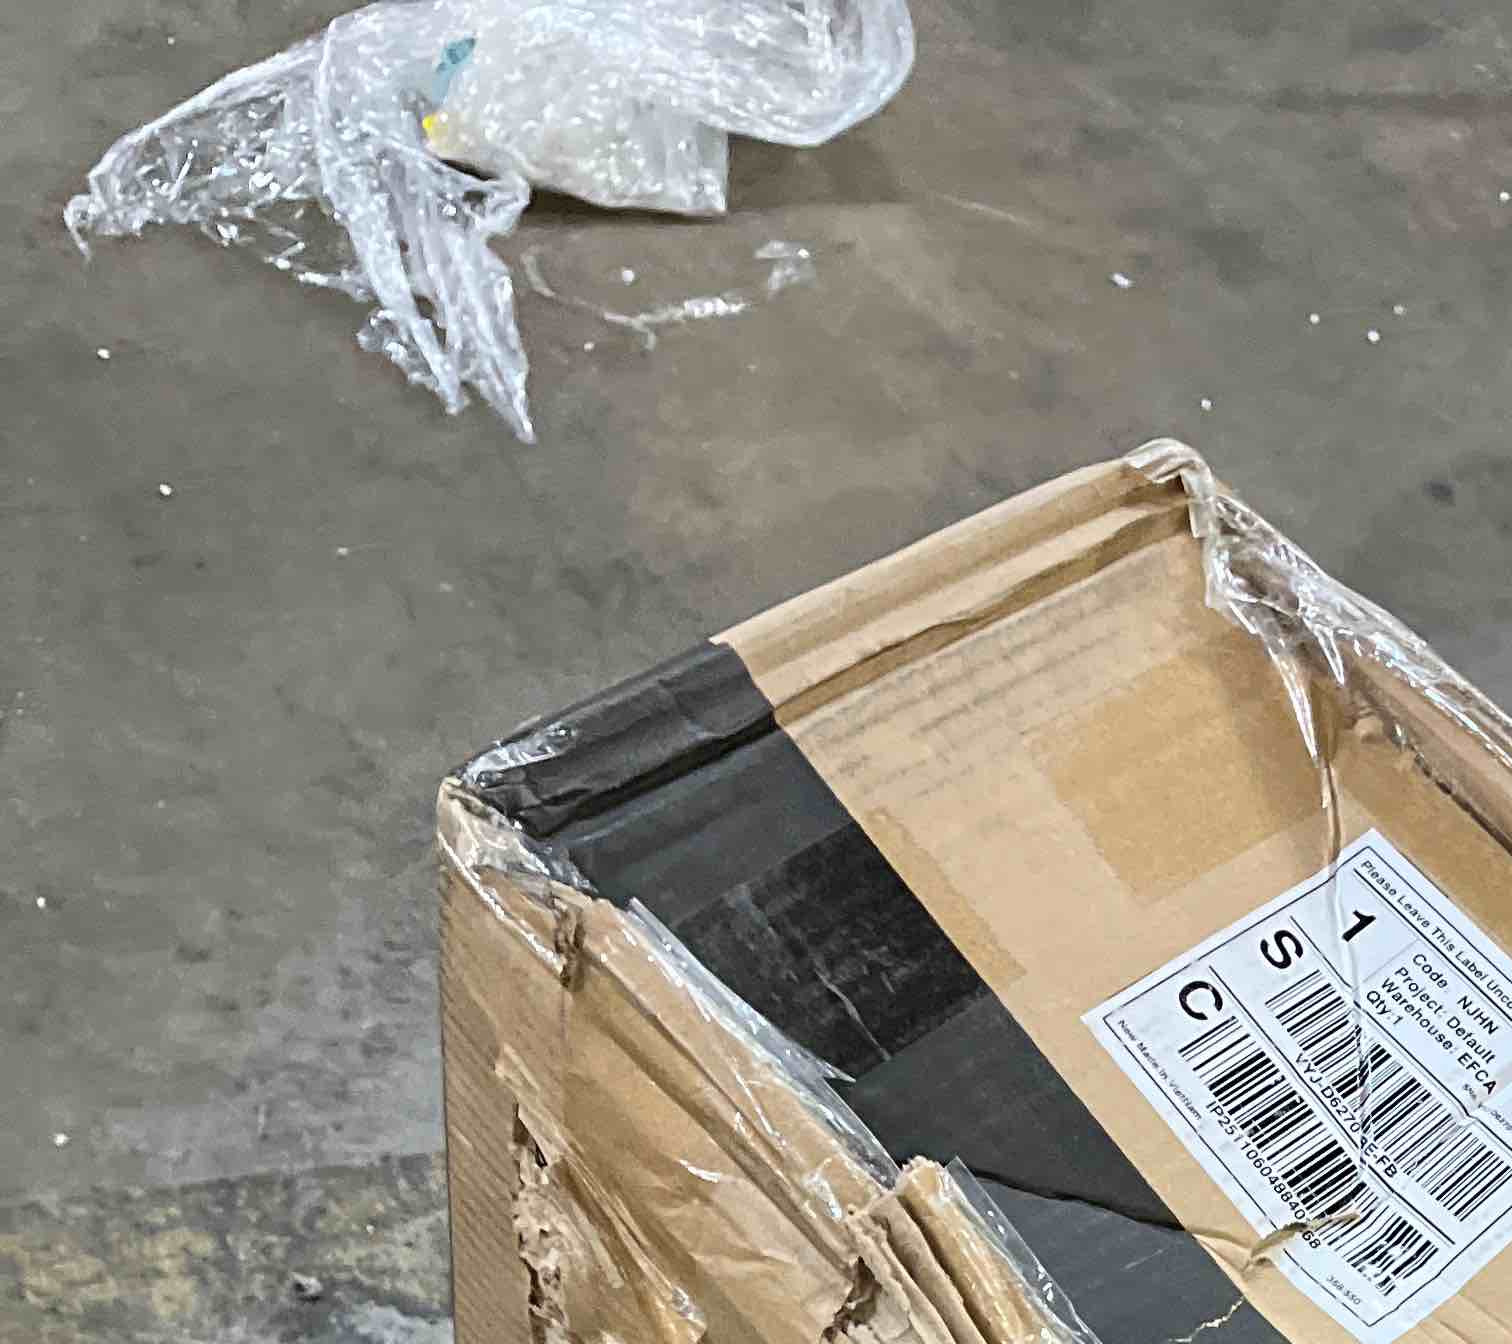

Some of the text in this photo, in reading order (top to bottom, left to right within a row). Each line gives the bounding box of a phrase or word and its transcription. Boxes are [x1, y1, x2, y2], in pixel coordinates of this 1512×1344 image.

[1342, 910, 1376, 942] 1
[1361, 861, 1396, 895] Please
[1398, 896, 1430, 927] Leave
[1432, 927, 1454, 951] This
[1456, 951, 1488, 980] Label
[1260, 927, 1302, 970] S
[1177, 978, 1224, 1022] C
[1457, 996, 1498, 1034] NJHN
[1447, 1016, 1495, 1064] Default
[1458, 1053, 1496, 1094] EFCA
[1206, 1101, 1320, 1248] IP25110604884068
